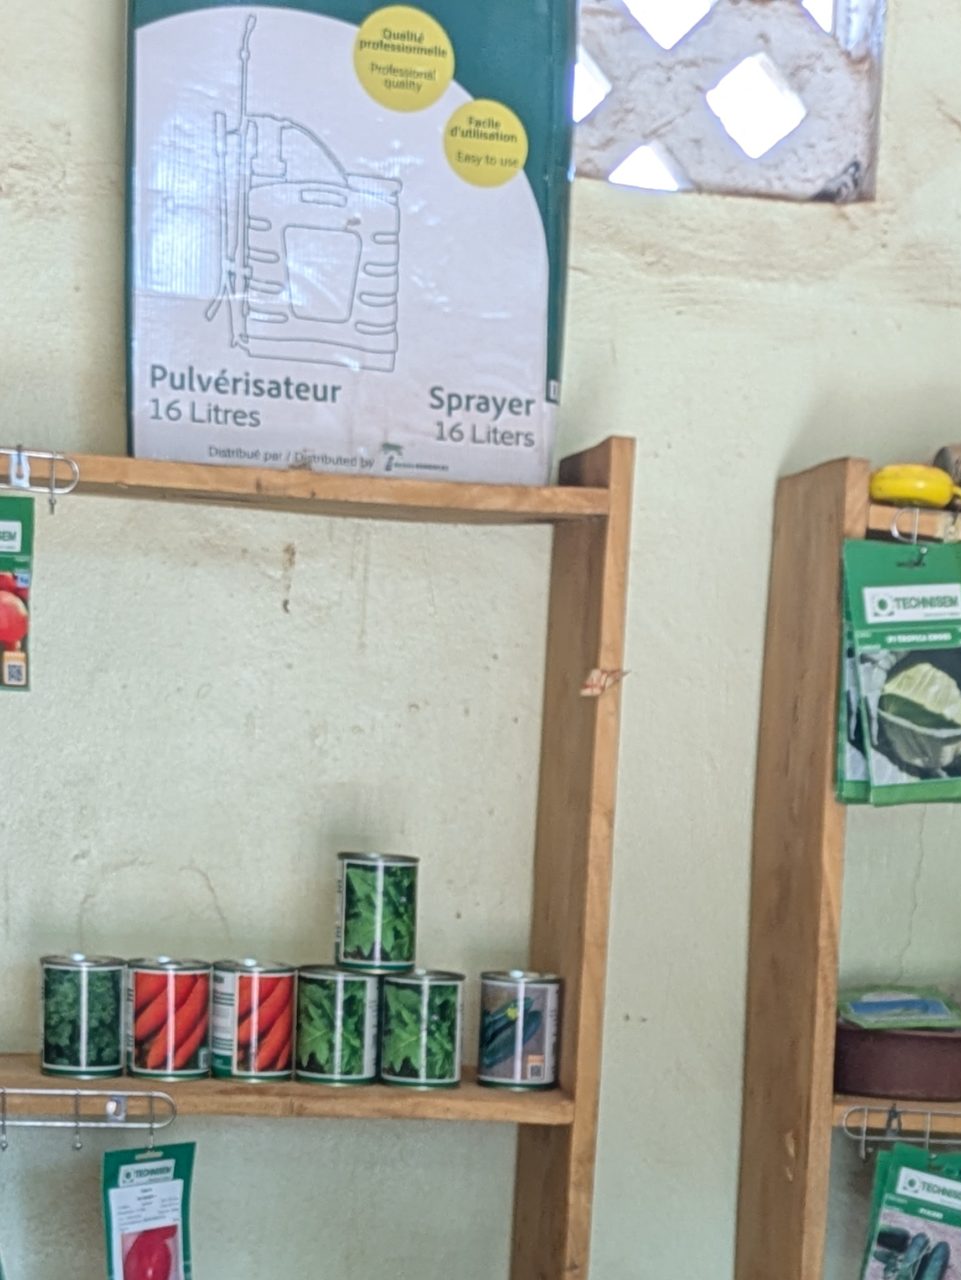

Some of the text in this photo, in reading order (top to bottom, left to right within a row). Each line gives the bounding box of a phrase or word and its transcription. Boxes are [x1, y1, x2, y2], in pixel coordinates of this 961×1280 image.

[382, 28, 425, 43] Qualité
[359, 39, 448, 58] professionnelle
[370, 61, 437, 81] Professional
[384, 79, 422, 93] quality
[468, 115, 501, 129] Facile
[450, 126, 518, 143] d'utilisation
[457, 151, 519, 168] Easy to use
[150, 364, 342, 403] Pulvérisateur
[150, 398, 261, 427] 16 Litres
[430, 386, 536, 421] Sprayer
[435, 421, 535, 447] 16 Liters
[208, 446, 261, 460] Distribué
[264, 450, 282, 463] par
[295, 451, 357, 465] Distributed
[360, 456, 375, 468] by
[894, 596, 960, 611] TECHNISEM
